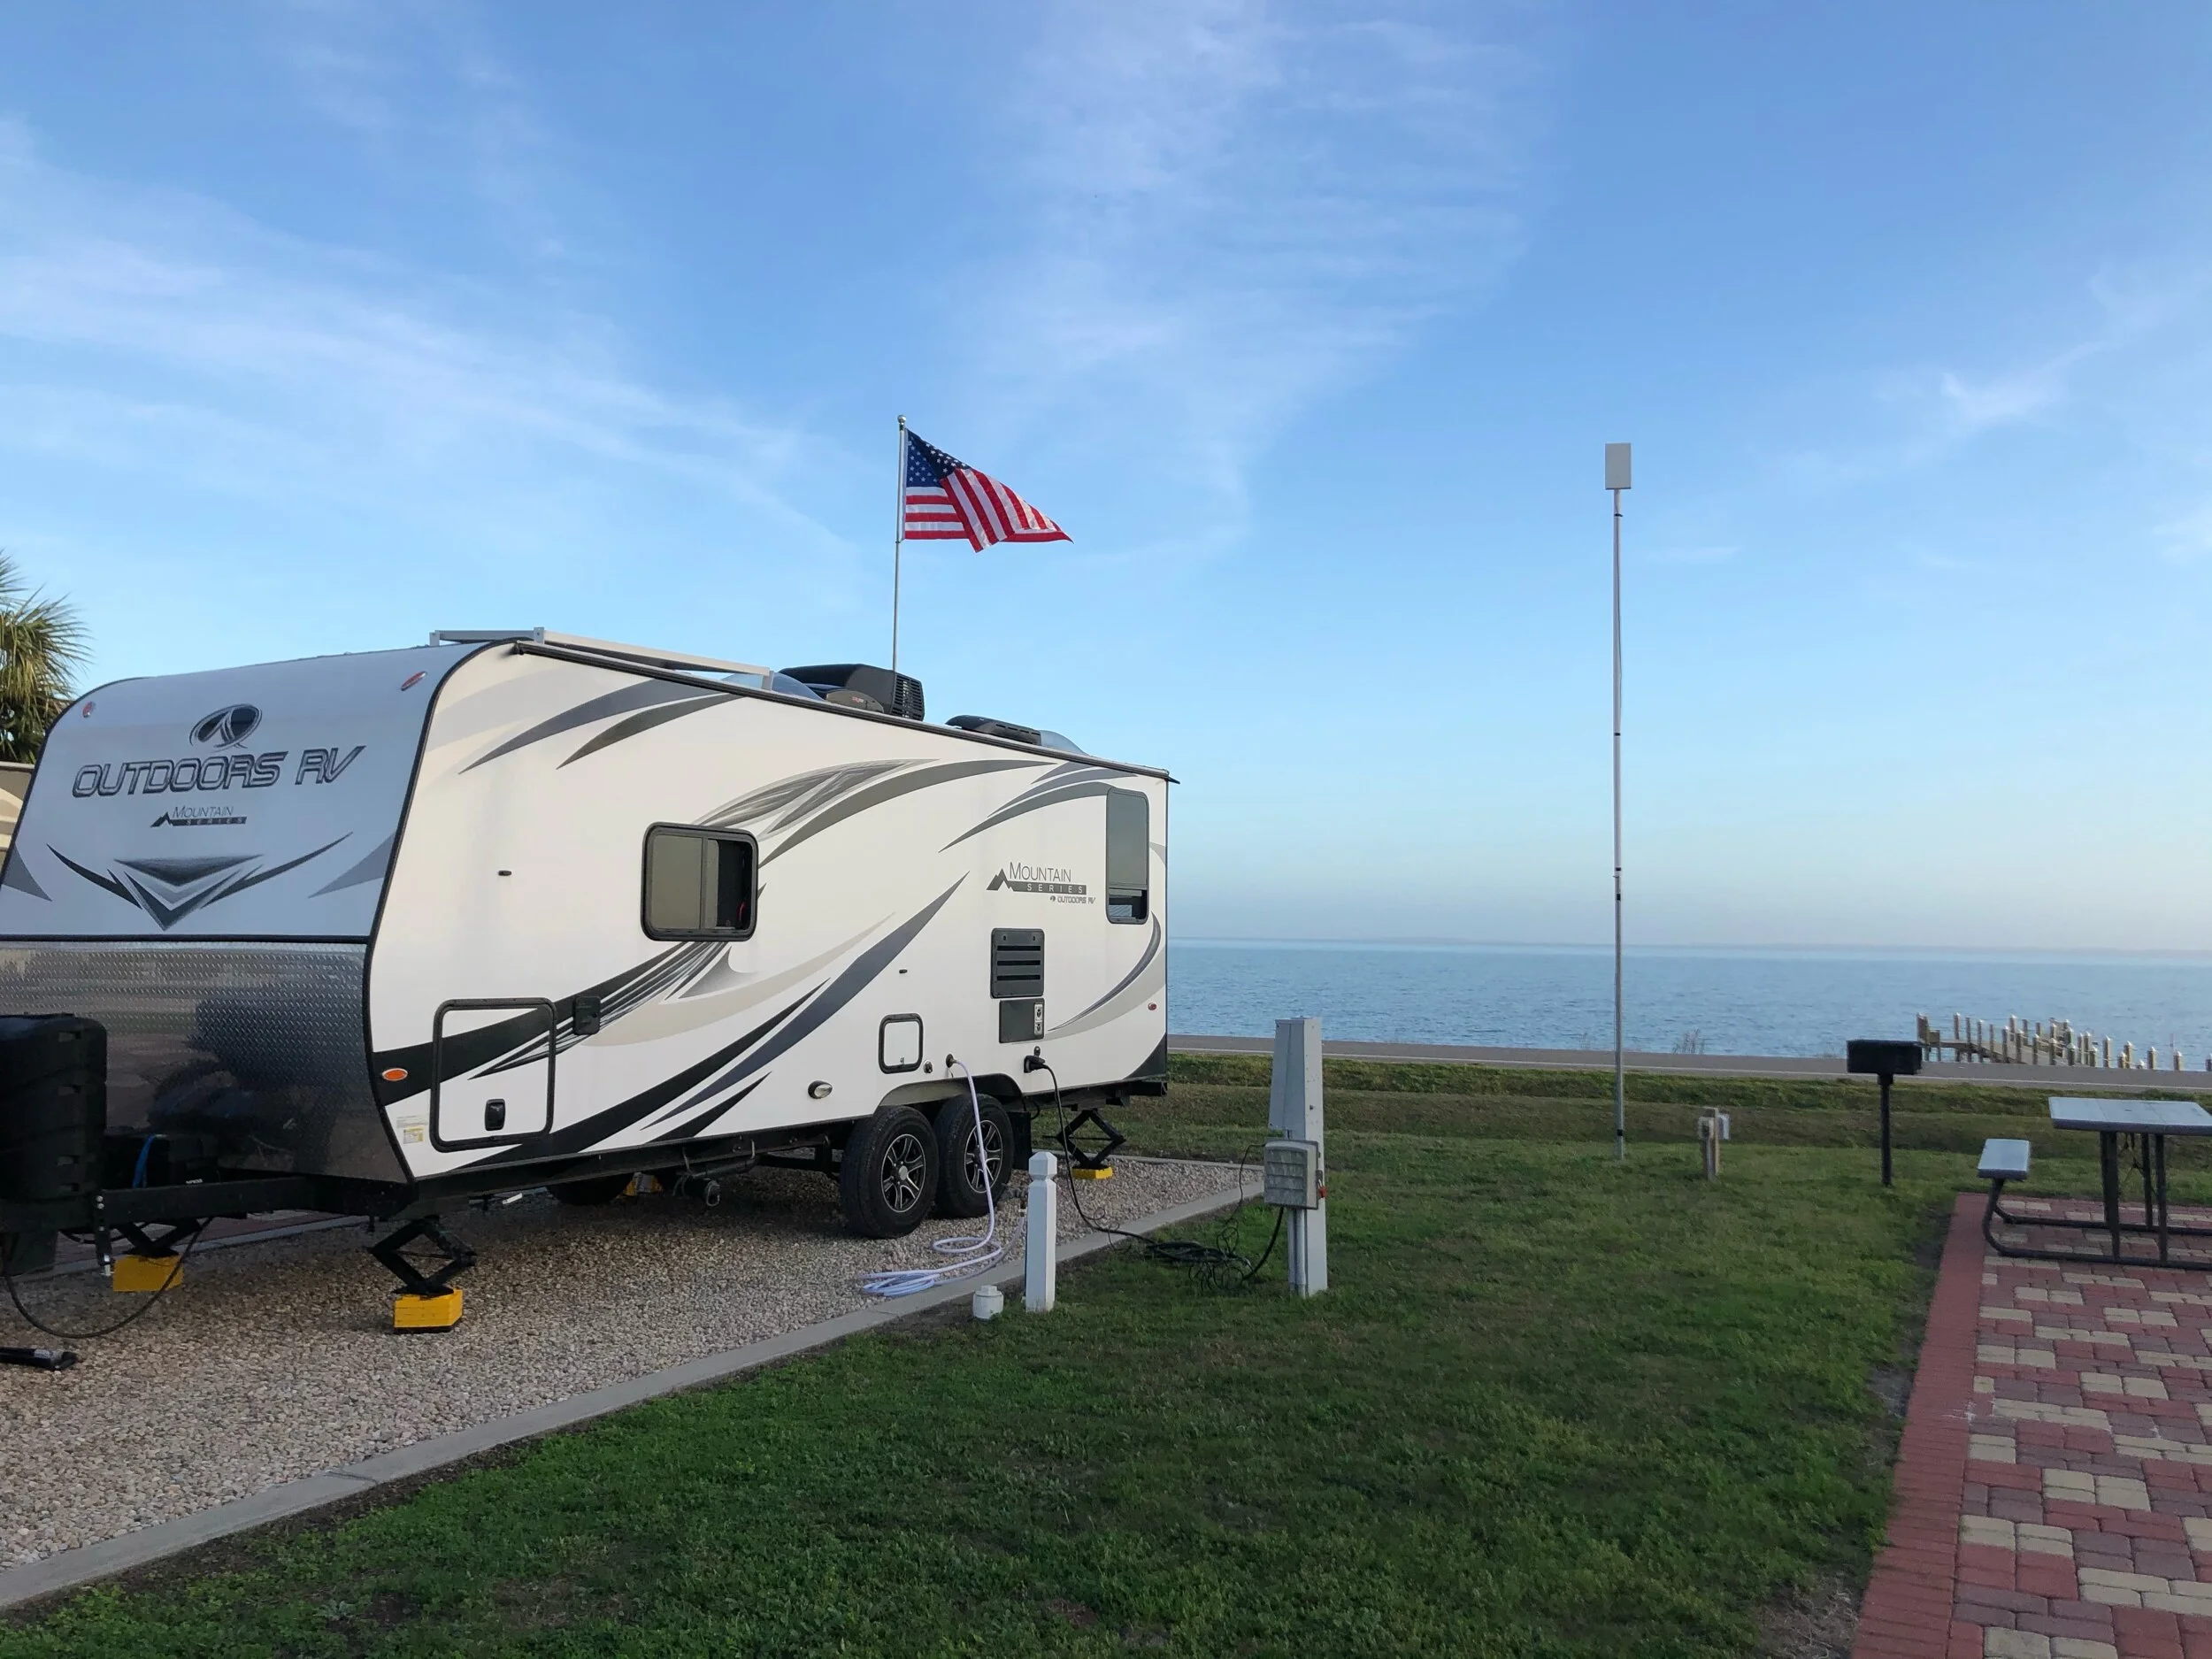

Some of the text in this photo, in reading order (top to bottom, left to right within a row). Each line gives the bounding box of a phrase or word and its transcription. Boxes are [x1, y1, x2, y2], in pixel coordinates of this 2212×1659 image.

[73, 745, 367, 798] OUTDOORS RV
[1026, 883, 1084, 894] SERIES
[1056, 895, 1087, 904] OUTDOORS
